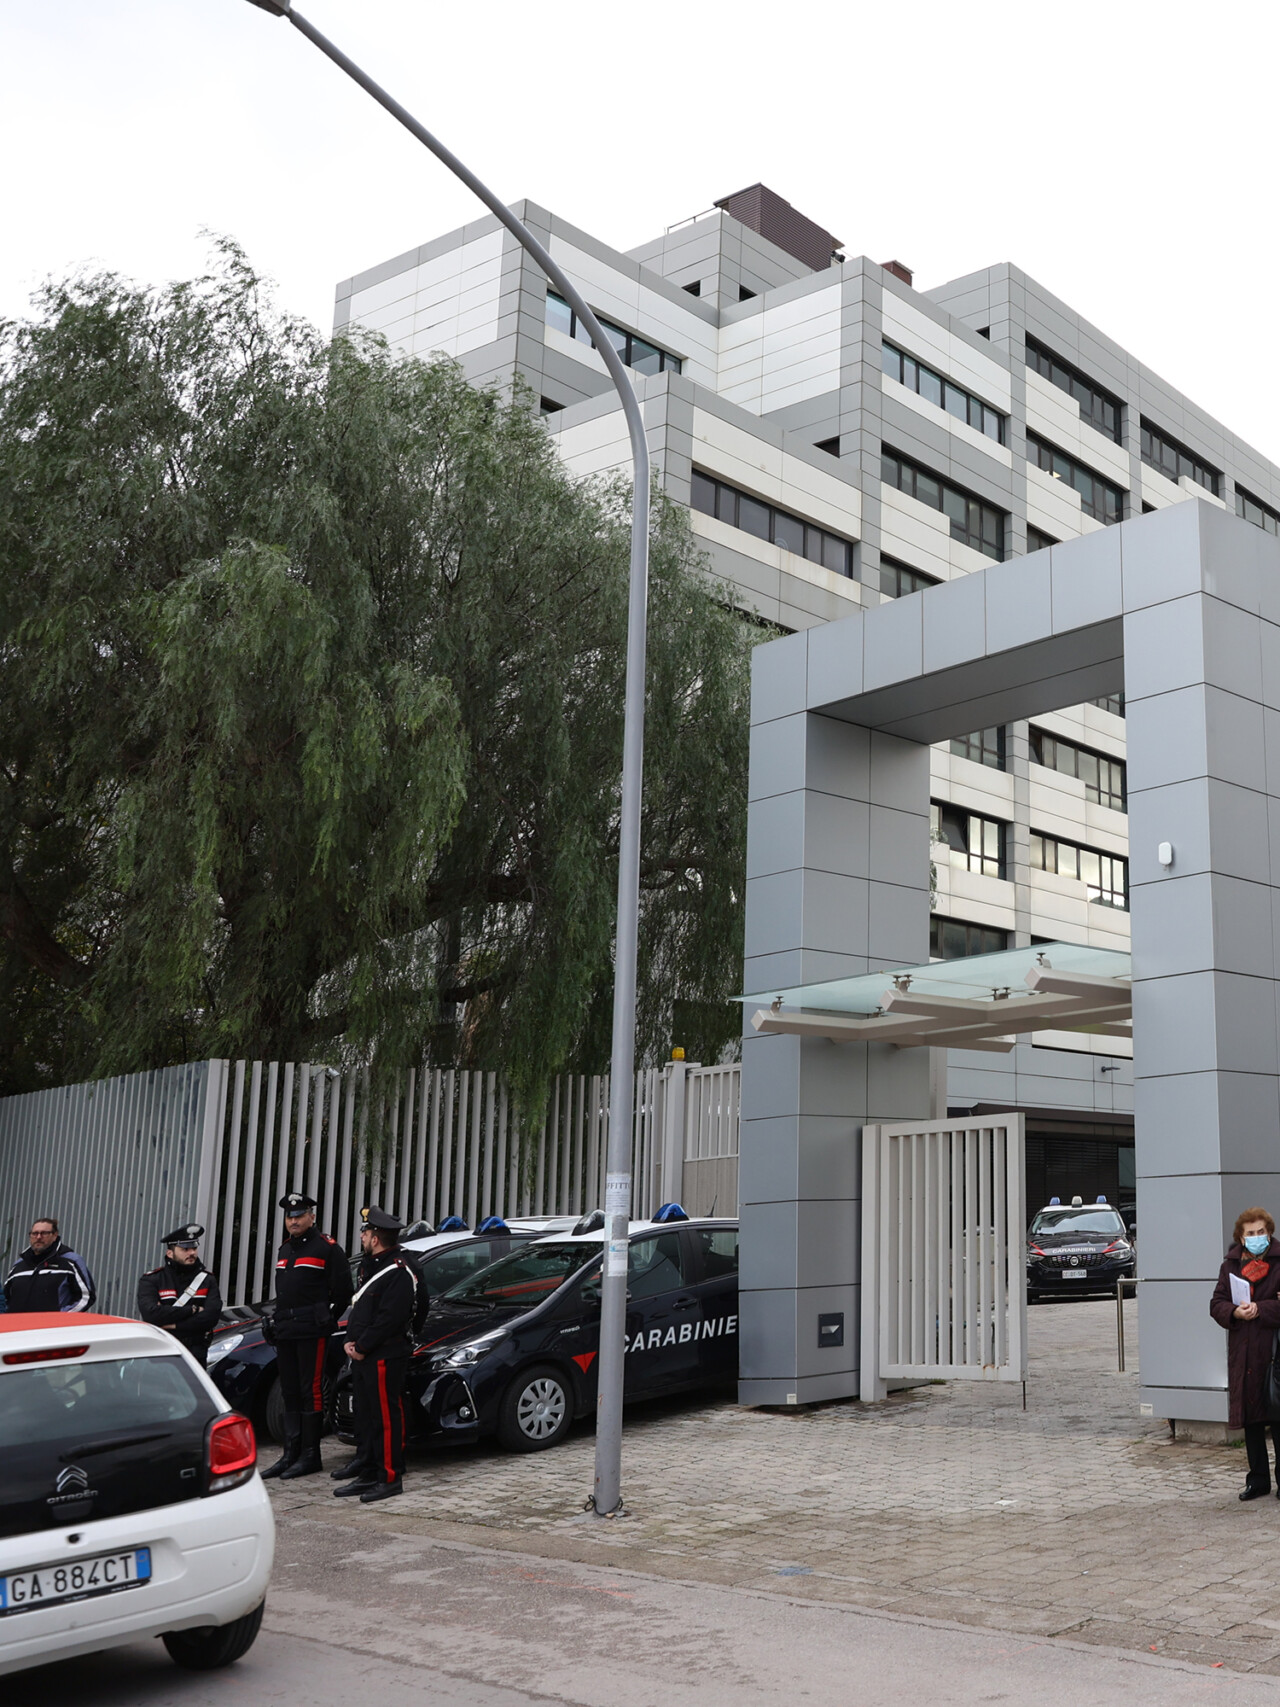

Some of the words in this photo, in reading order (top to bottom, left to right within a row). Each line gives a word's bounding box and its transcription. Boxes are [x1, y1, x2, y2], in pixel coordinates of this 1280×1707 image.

[623, 1315, 738, 1354] CARABINIE
[12, 1573, 43, 1602] GA
[54, 1555, 132, 1593] 884CT
